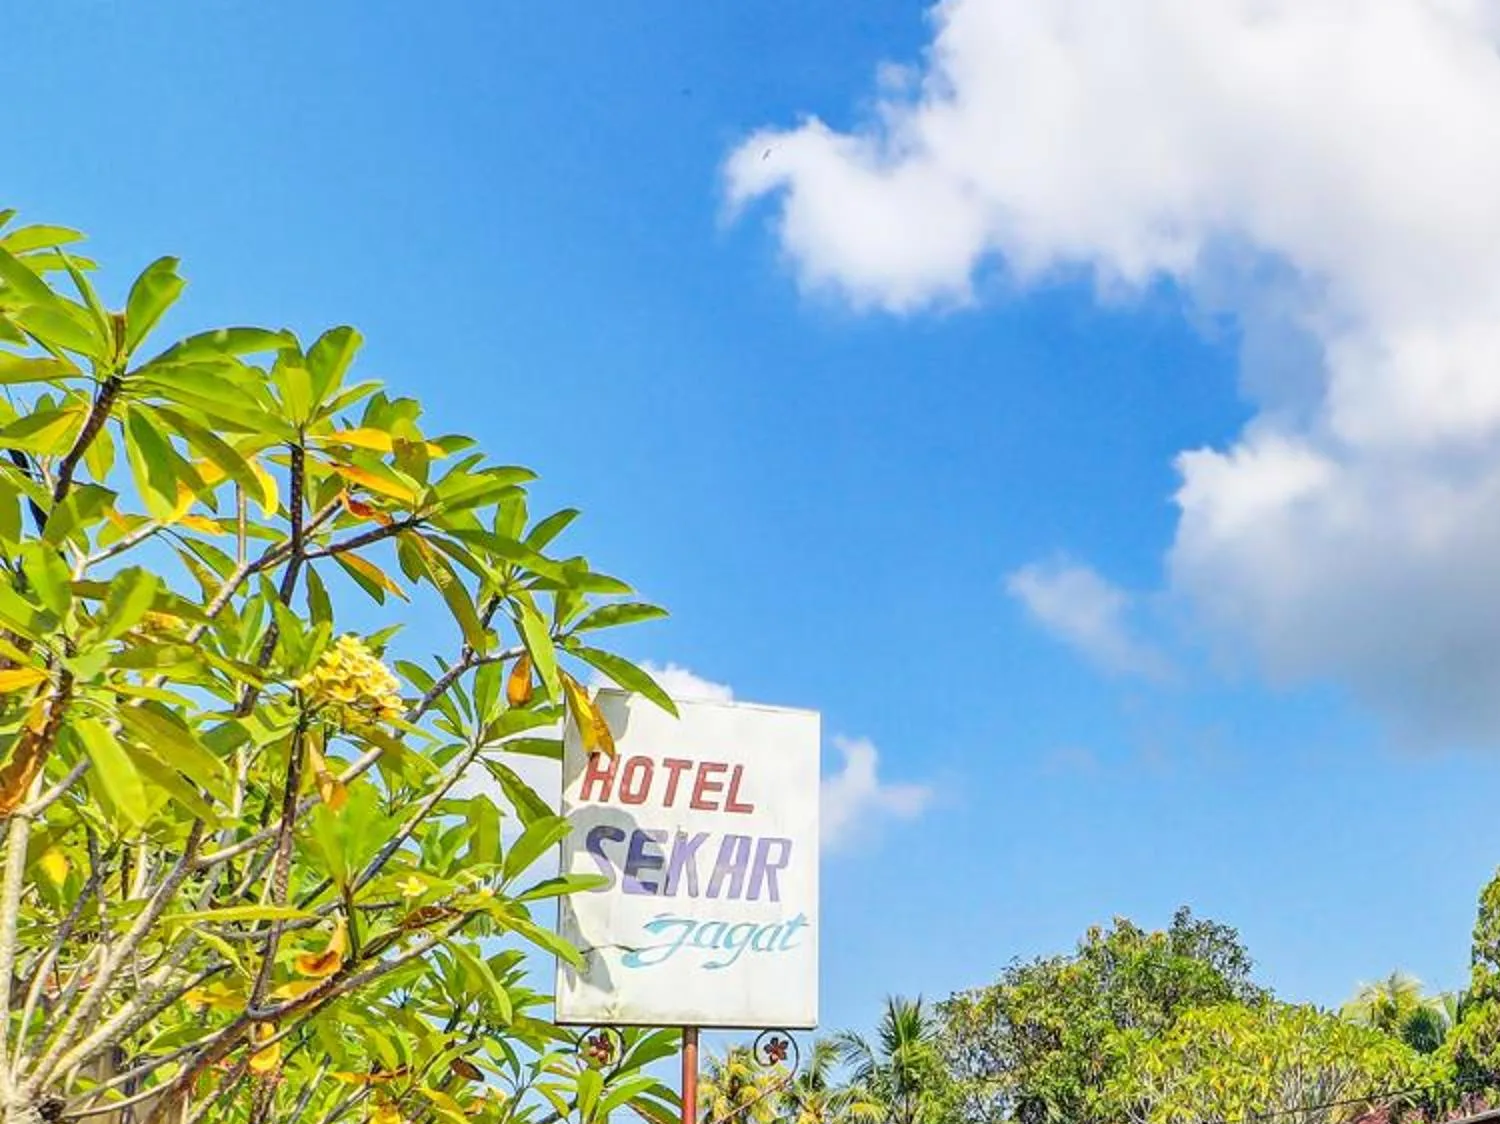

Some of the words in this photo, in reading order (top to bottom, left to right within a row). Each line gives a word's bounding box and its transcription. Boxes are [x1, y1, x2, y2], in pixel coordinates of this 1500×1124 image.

[579, 751, 754, 813] HOTEL
[586, 825, 792, 901] SEKAR
[621, 912, 810, 969] Jagat
